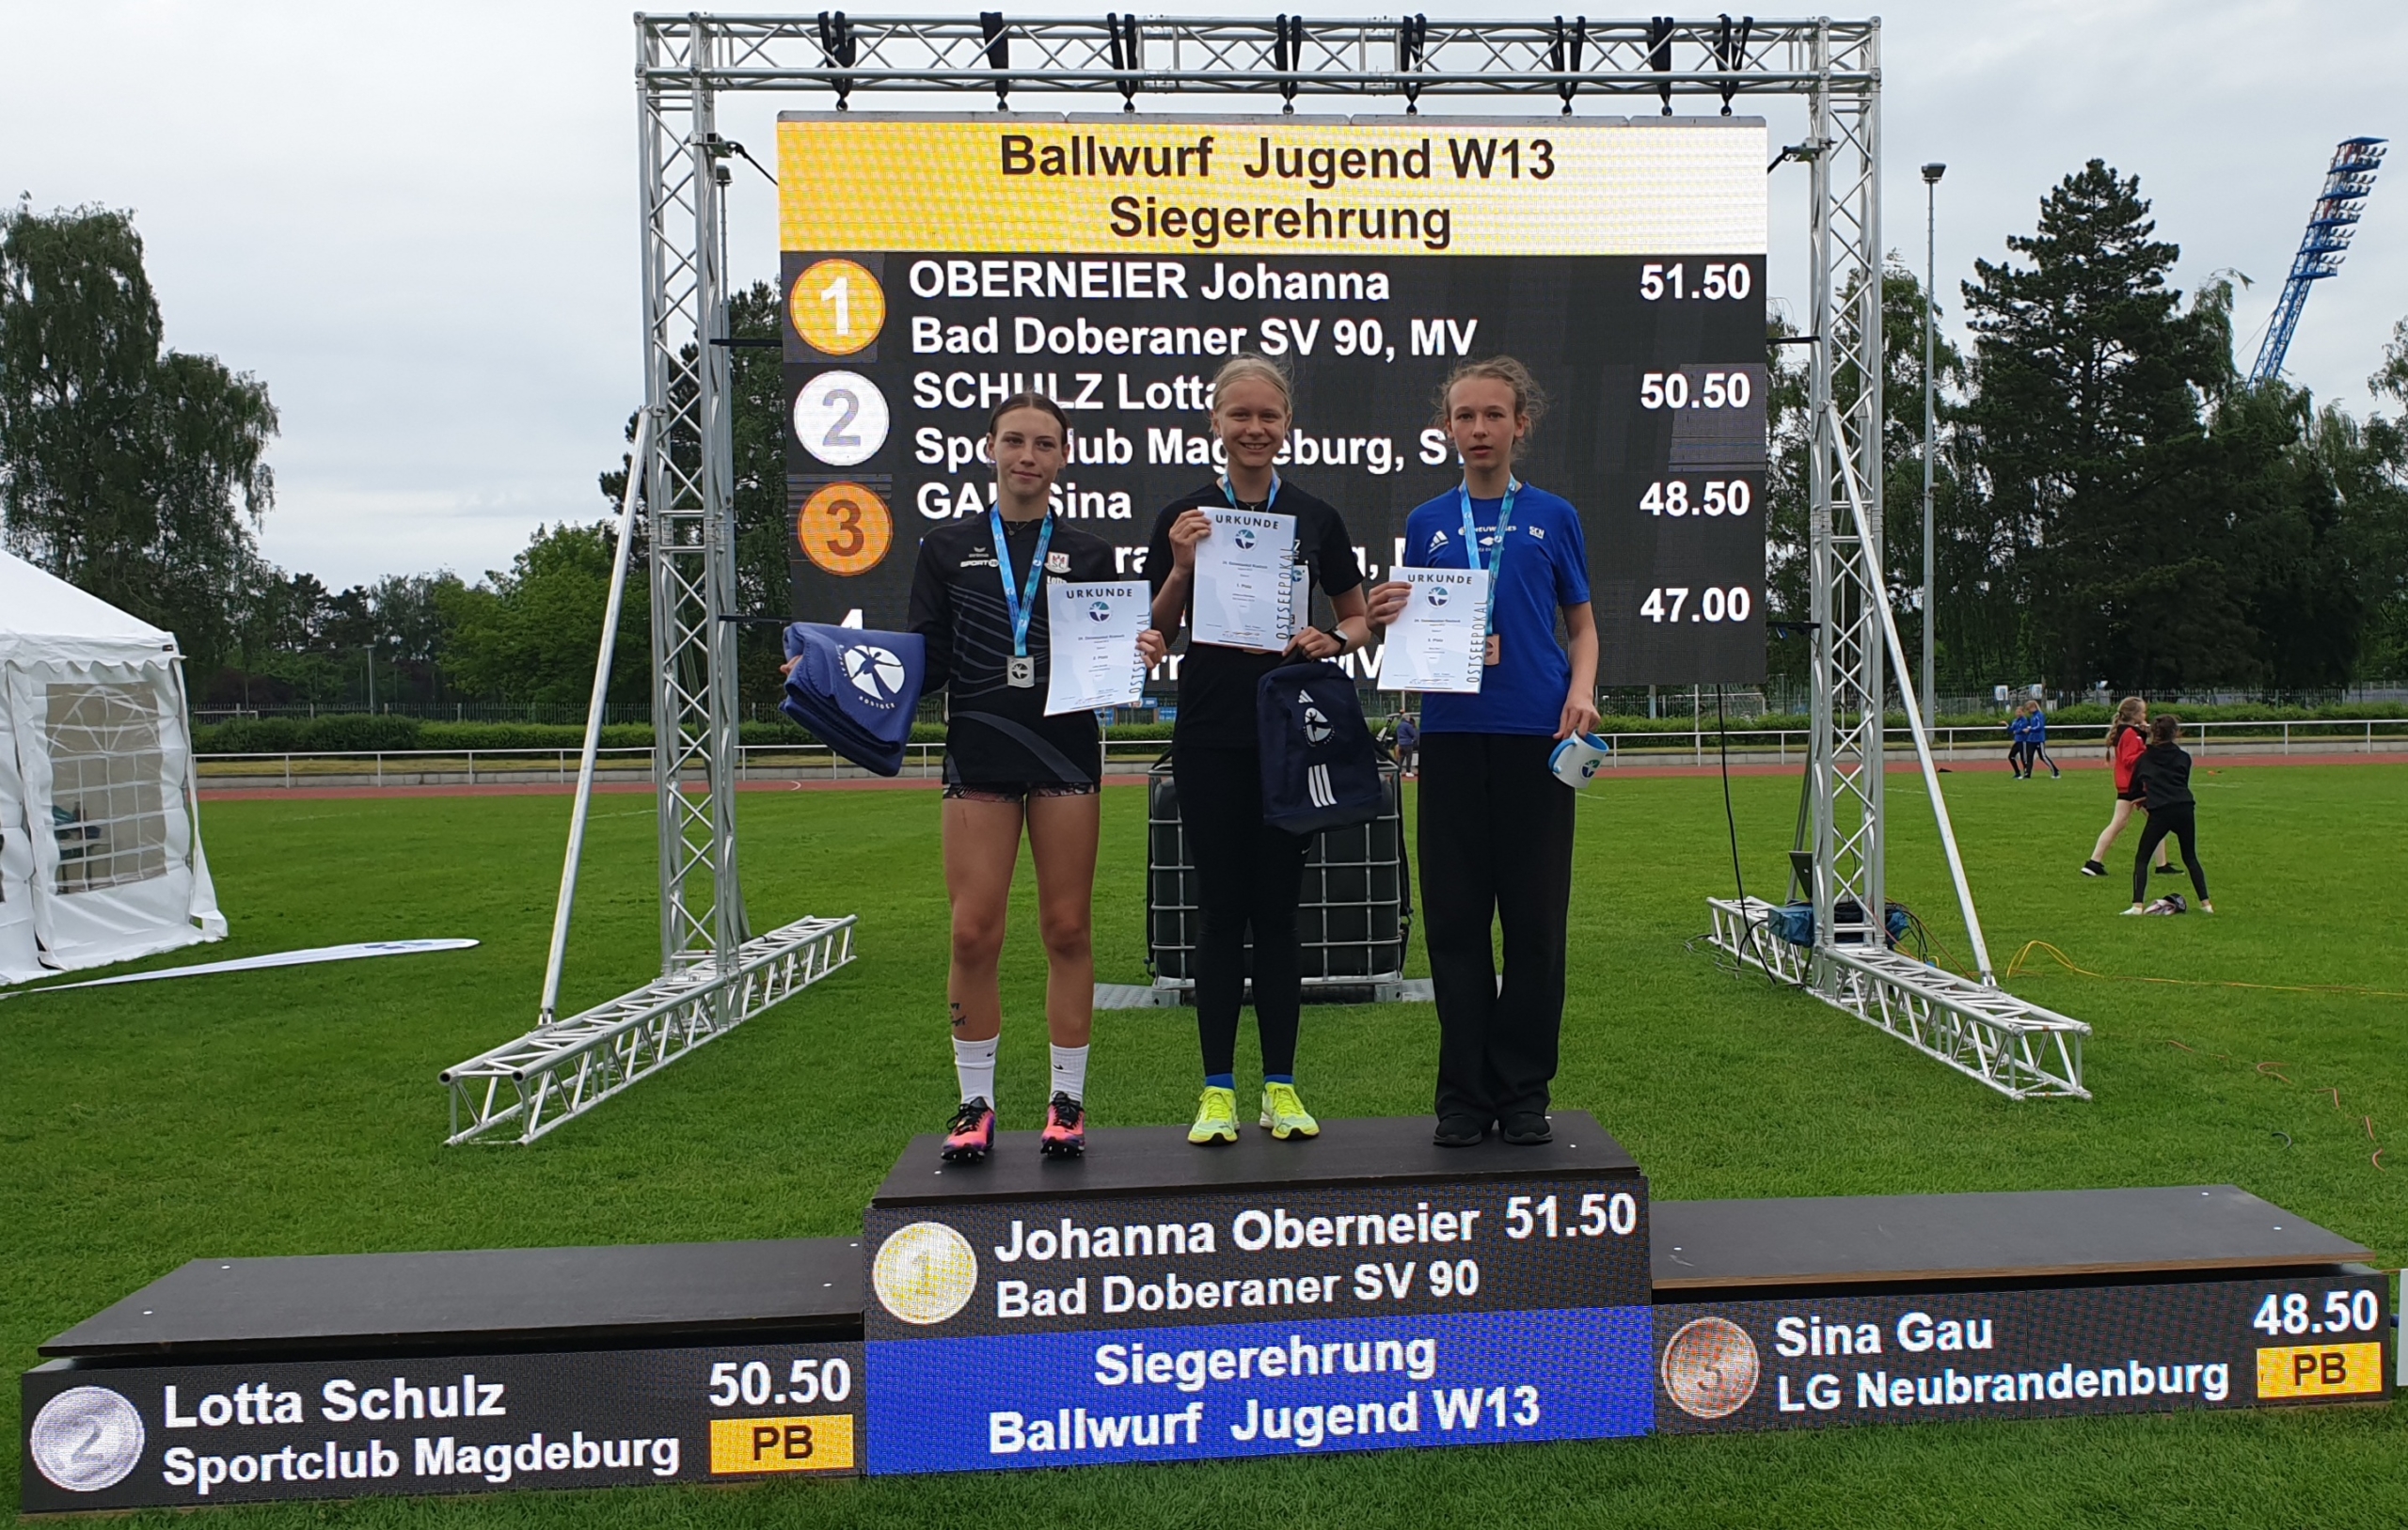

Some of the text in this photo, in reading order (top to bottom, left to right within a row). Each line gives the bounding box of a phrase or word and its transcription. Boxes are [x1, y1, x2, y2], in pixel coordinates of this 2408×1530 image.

[1002, 135, 1556, 190] Ballwurf Jugend W13
[1111, 197, 1451, 251] Siegerehrung
[910, 260, 1390, 302] OBERNEIER Johanna
[1641, 263, 1751, 302] 51.50
[820, 276, 849, 337] 1
[912, 317, 1479, 364] Bad Doberaner SV 90, MV
[912, 371, 1104, 410] SCHULZ
[1641, 373, 1751, 410] 50.50
[821, 388, 862, 447] 2
[914, 426, 1464, 475] Splub Mageburg, S
[1215, 513, 1280, 530] URKUNDE
[1640, 481, 1751, 518] 48.50
[826, 499, 864, 557] 3
[1066, 588, 1133, 600] URKUNDE
[1275, 547, 1294, 640] OSTSEEPOKAL
[1407, 574, 1473, 585] URKUNDE
[1640, 588, 1751, 623] 47.00
[1129, 611, 1150, 694] OSTSEEAL
[1465, 600, 1488, 684] OSTSEEPOKAL
[995, 1193, 1638, 1263] Johanna Oberneier 51.50
[998, 1260, 1480, 1319] Bad Doberaner SV 90
[2254, 1290, 2379, 1336] 48.50
[1776, 1313, 1993, 1358] Sina Gau
[710, 1359, 852, 1408] 50.50
[1094, 1336, 1436, 1393] Siegerehrung
[1780, 1361, 2229, 1412] LG Neubrandenburg
[2291, 1350, 2348, 1387] PB
[166, 1375, 507, 1429] Lotta Schulz
[989, 1385, 1541, 1454] Ballwurf Jugend W13
[164, 1432, 680, 1496] Sportclub Magdeburg
[752, 1424, 816, 1461] PB
